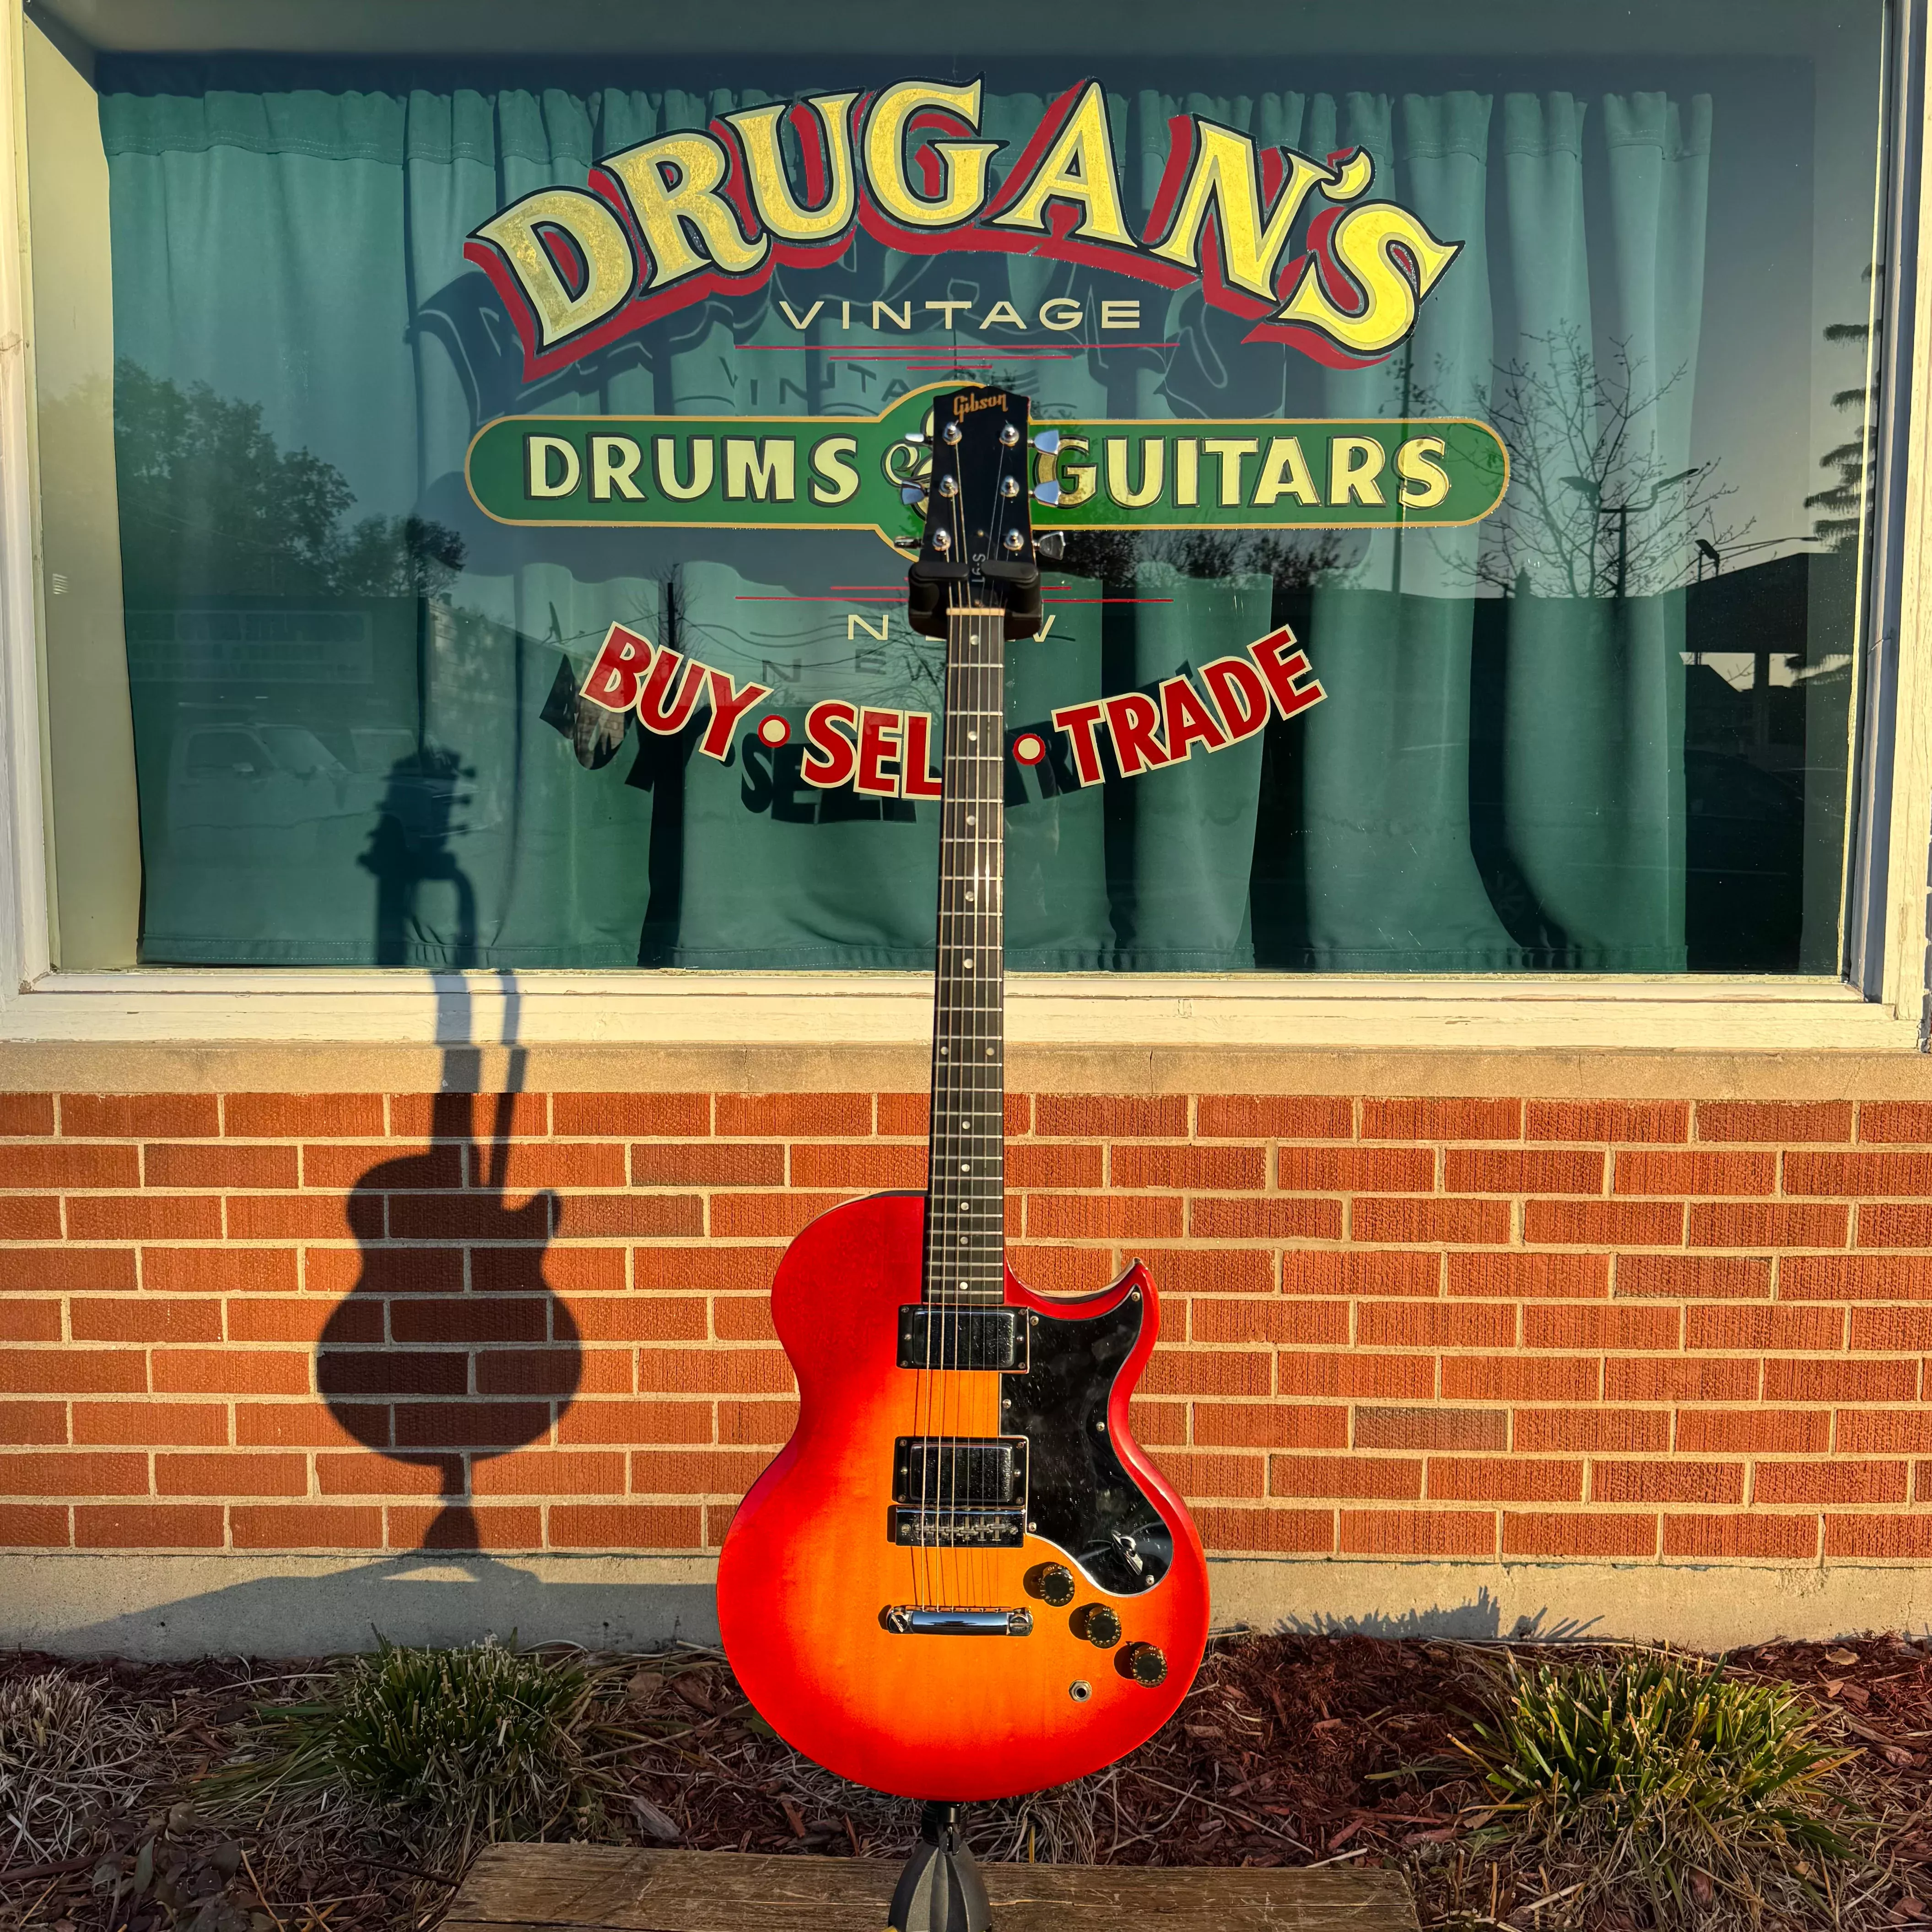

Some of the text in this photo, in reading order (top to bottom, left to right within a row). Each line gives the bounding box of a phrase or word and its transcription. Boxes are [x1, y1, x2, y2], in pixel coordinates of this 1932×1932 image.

[465, 72, 1465, 362] DRUGAN'S
[779, 299, 1140, 330] VINTAGE
[953, 393, 1009, 423] Gibson
[524, 433, 861, 507] DRUMS
[1032, 434, 1451, 511] GUITARS
[580, 621, 773, 761] BUY
[801, 700, 942, 800] SEL
[1051, 624, 1328, 788] TRADE
